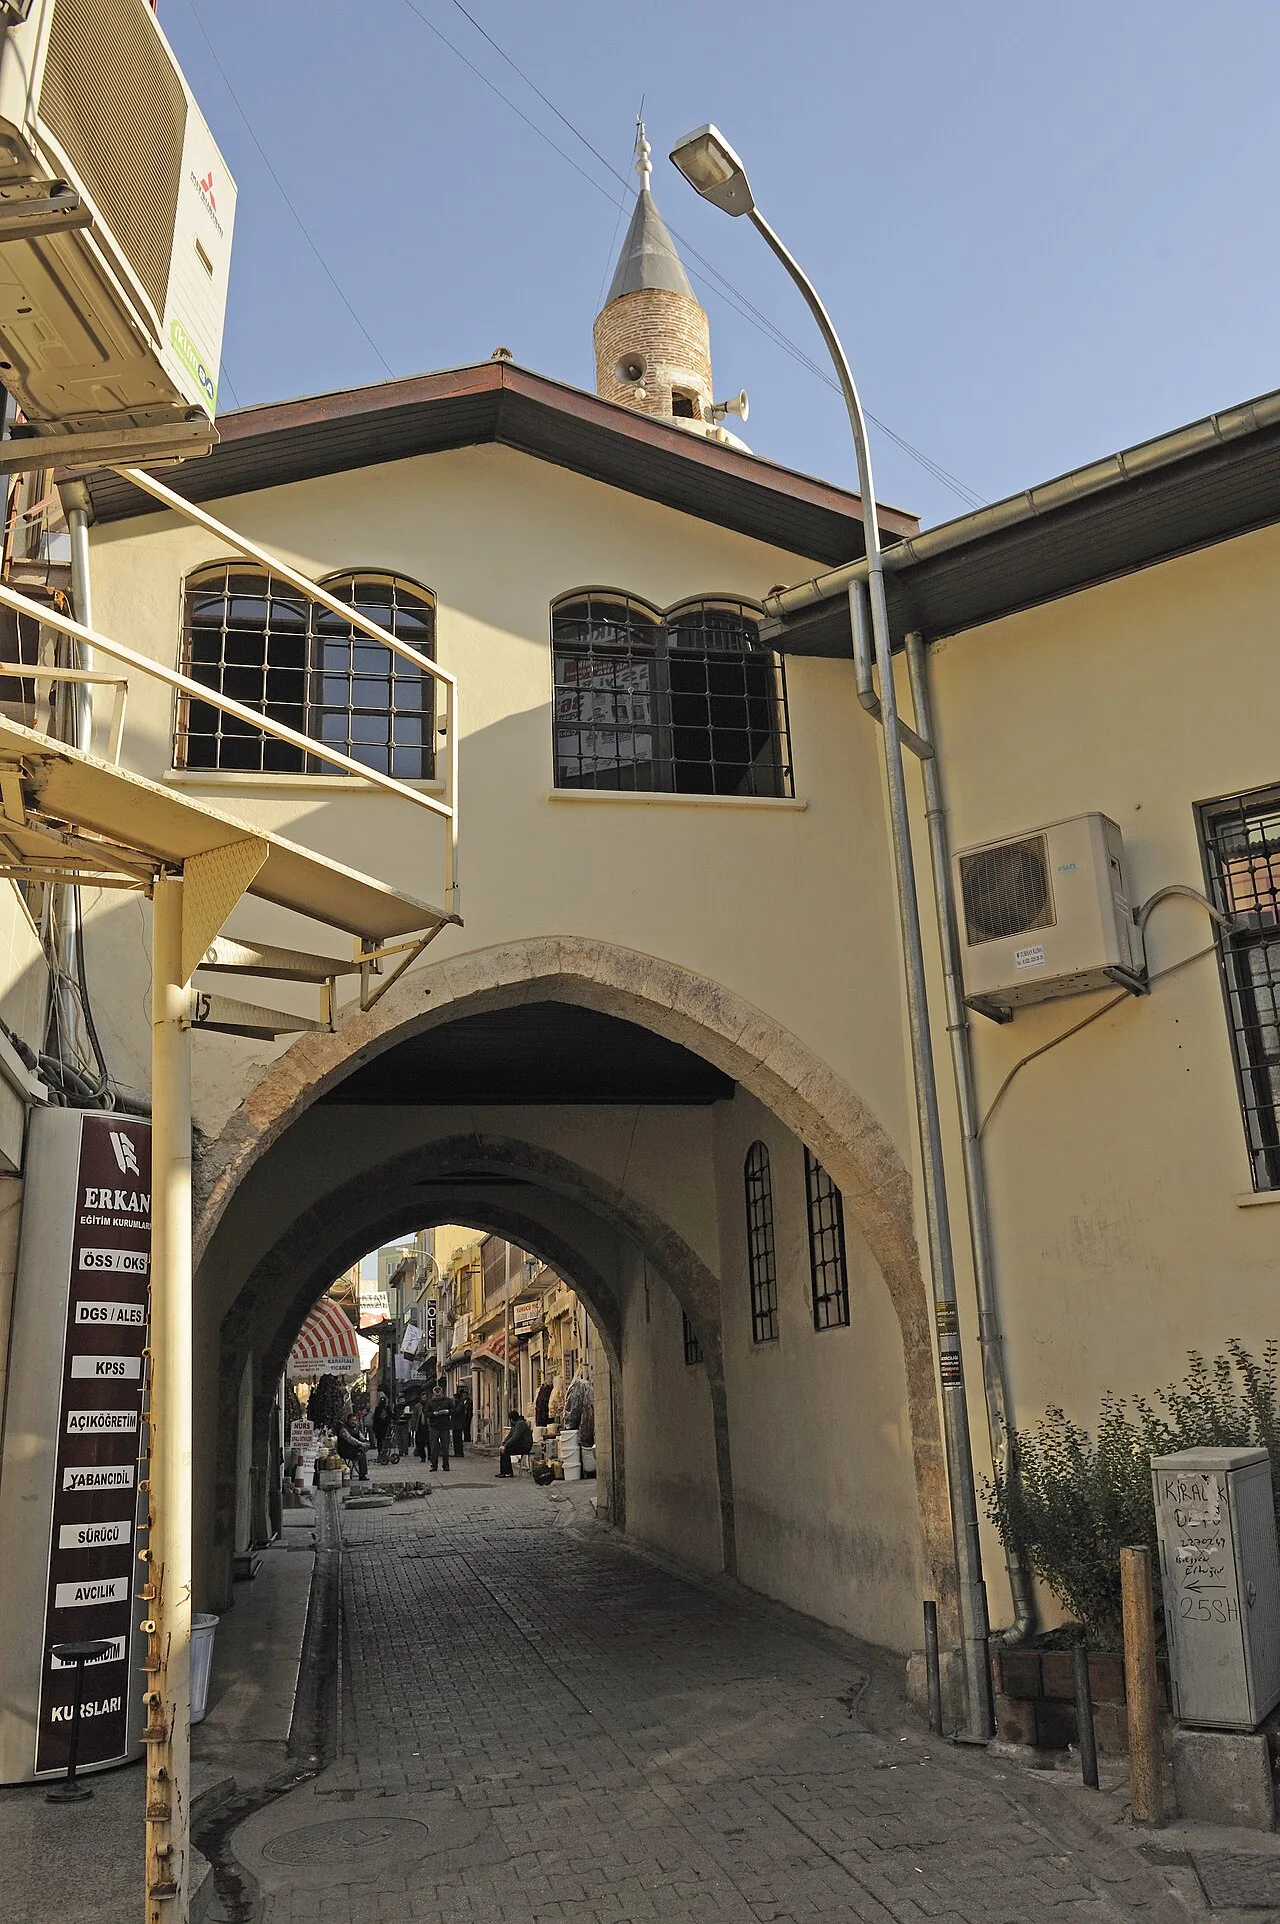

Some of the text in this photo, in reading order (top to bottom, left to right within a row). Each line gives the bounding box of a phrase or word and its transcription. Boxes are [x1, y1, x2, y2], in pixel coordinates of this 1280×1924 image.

[196, 991, 211, 1021] 15
[84, 1187, 151, 1213] ERKAN
[80, 1214, 111, 1226] EĞİTİM
[83, 1251, 113, 1269] ÖSS
[123, 1256, 146, 1271] OKS
[80, 1307, 108, 1321] DGS
[116, 1308, 142, 1323] ALES
[427, 1307, 438, 1348] OTEL
[95, 1361, 125, 1375] KPSS
[69, 1413, 136, 1432] AÇIKÖĞRETİM
[77, 1525, 120, 1544] SÜRÜCÜ
[74, 1583, 116, 1601] AVCILIK
